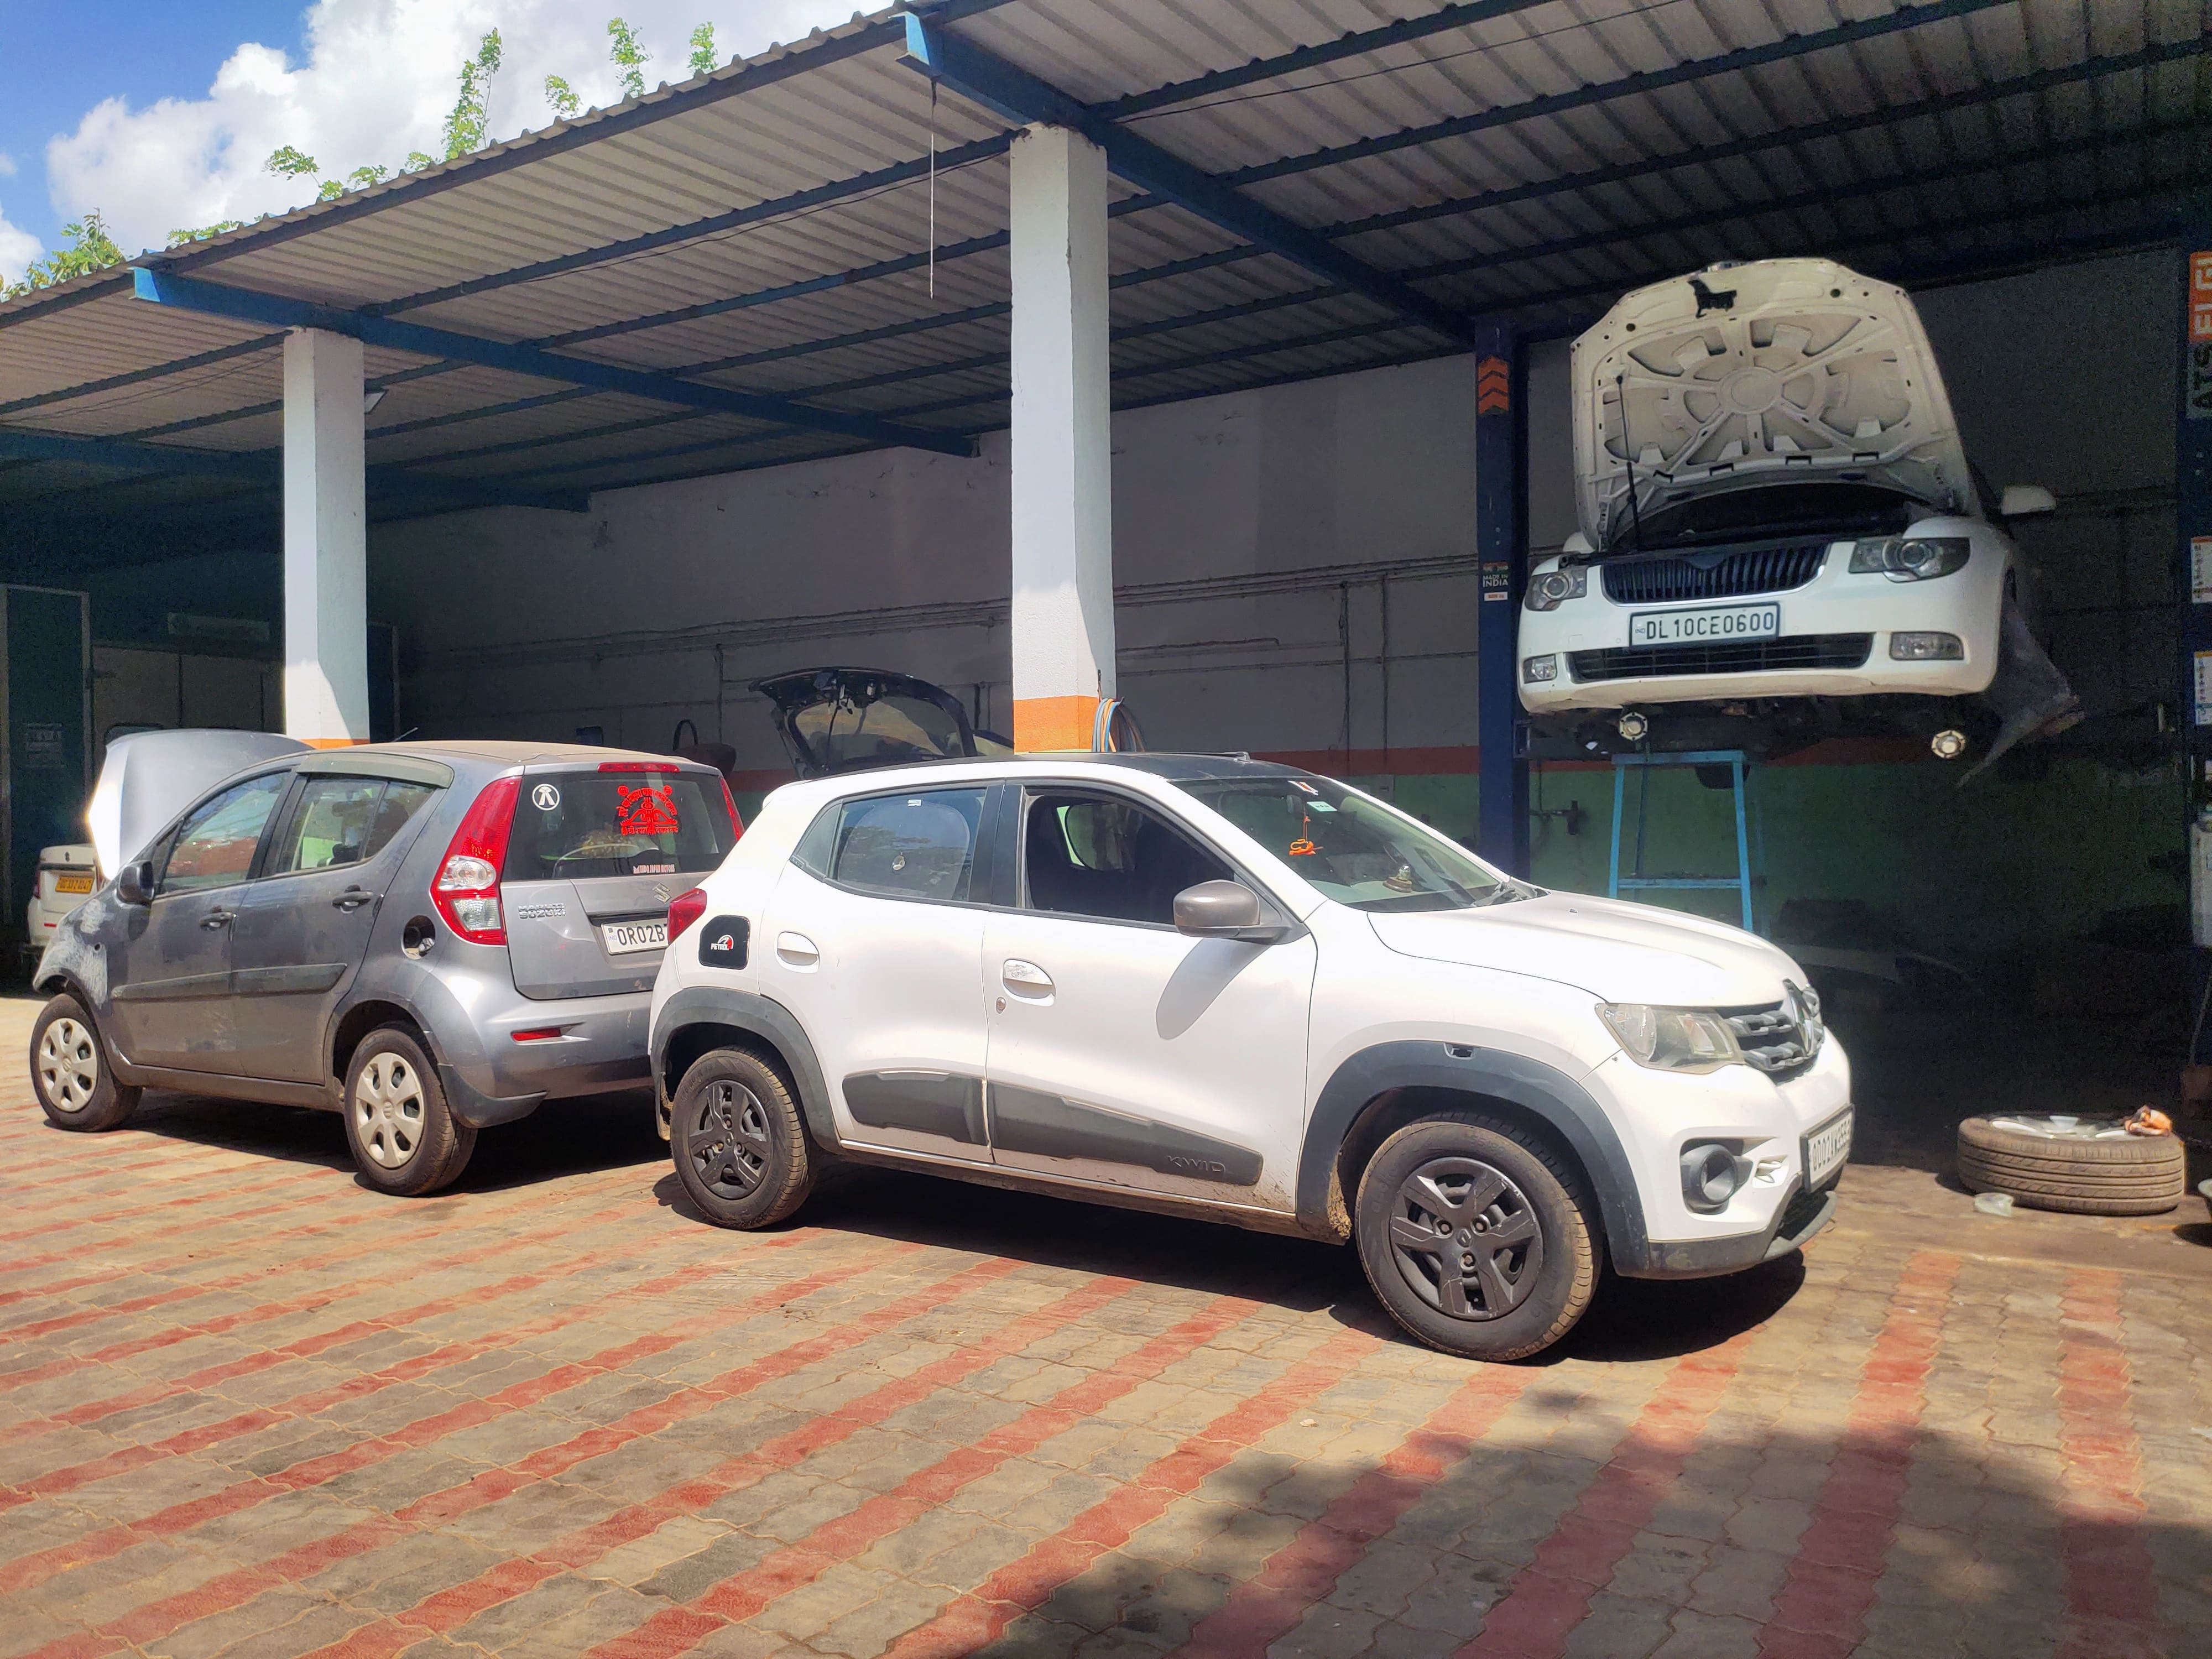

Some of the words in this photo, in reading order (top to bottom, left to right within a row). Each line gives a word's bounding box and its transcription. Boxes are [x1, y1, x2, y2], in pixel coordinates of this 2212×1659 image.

[1483, 579, 1509, 588] INDIA
[1646, 612, 1774, 640] DL10CE0600
[519, 909, 566, 919] SUZUKI
[617, 924, 667, 946] OR02B
[1168, 1155, 1226, 1173] KWID
